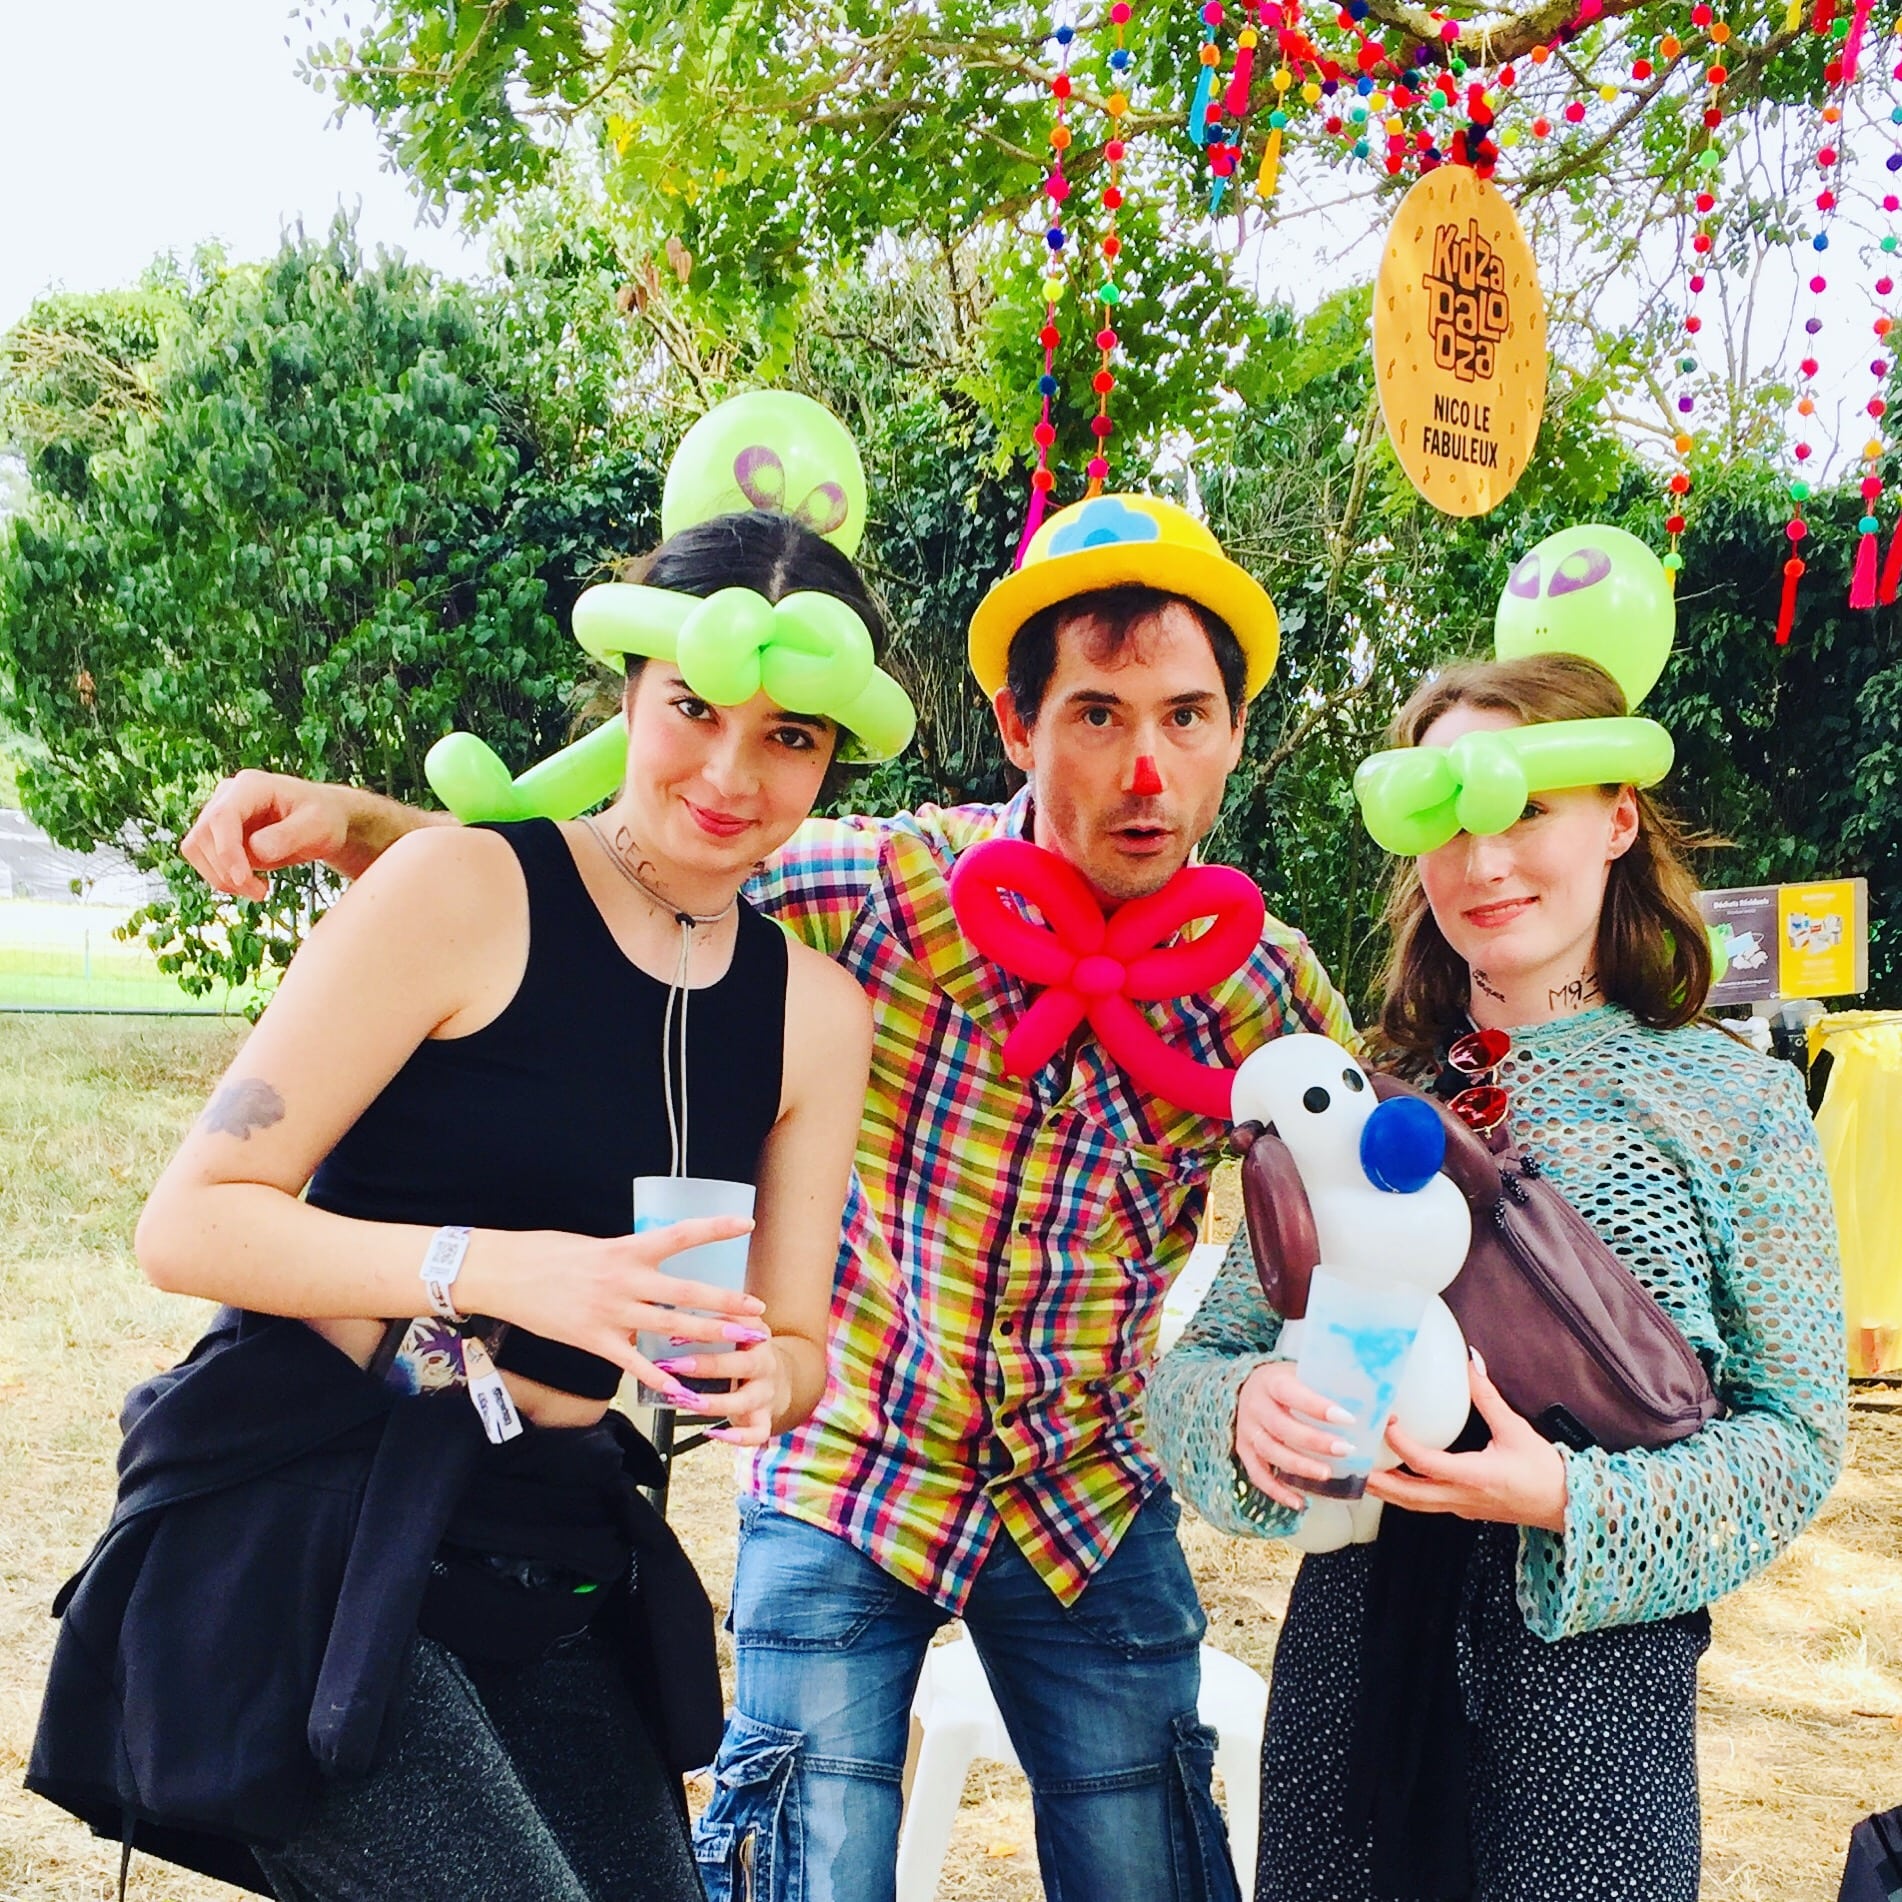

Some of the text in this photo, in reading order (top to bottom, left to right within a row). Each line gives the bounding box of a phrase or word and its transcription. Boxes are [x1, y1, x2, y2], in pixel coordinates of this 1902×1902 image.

[1434, 394, 1491, 433] NICO LE
[1423, 427, 1499, 469] FABULEUX
